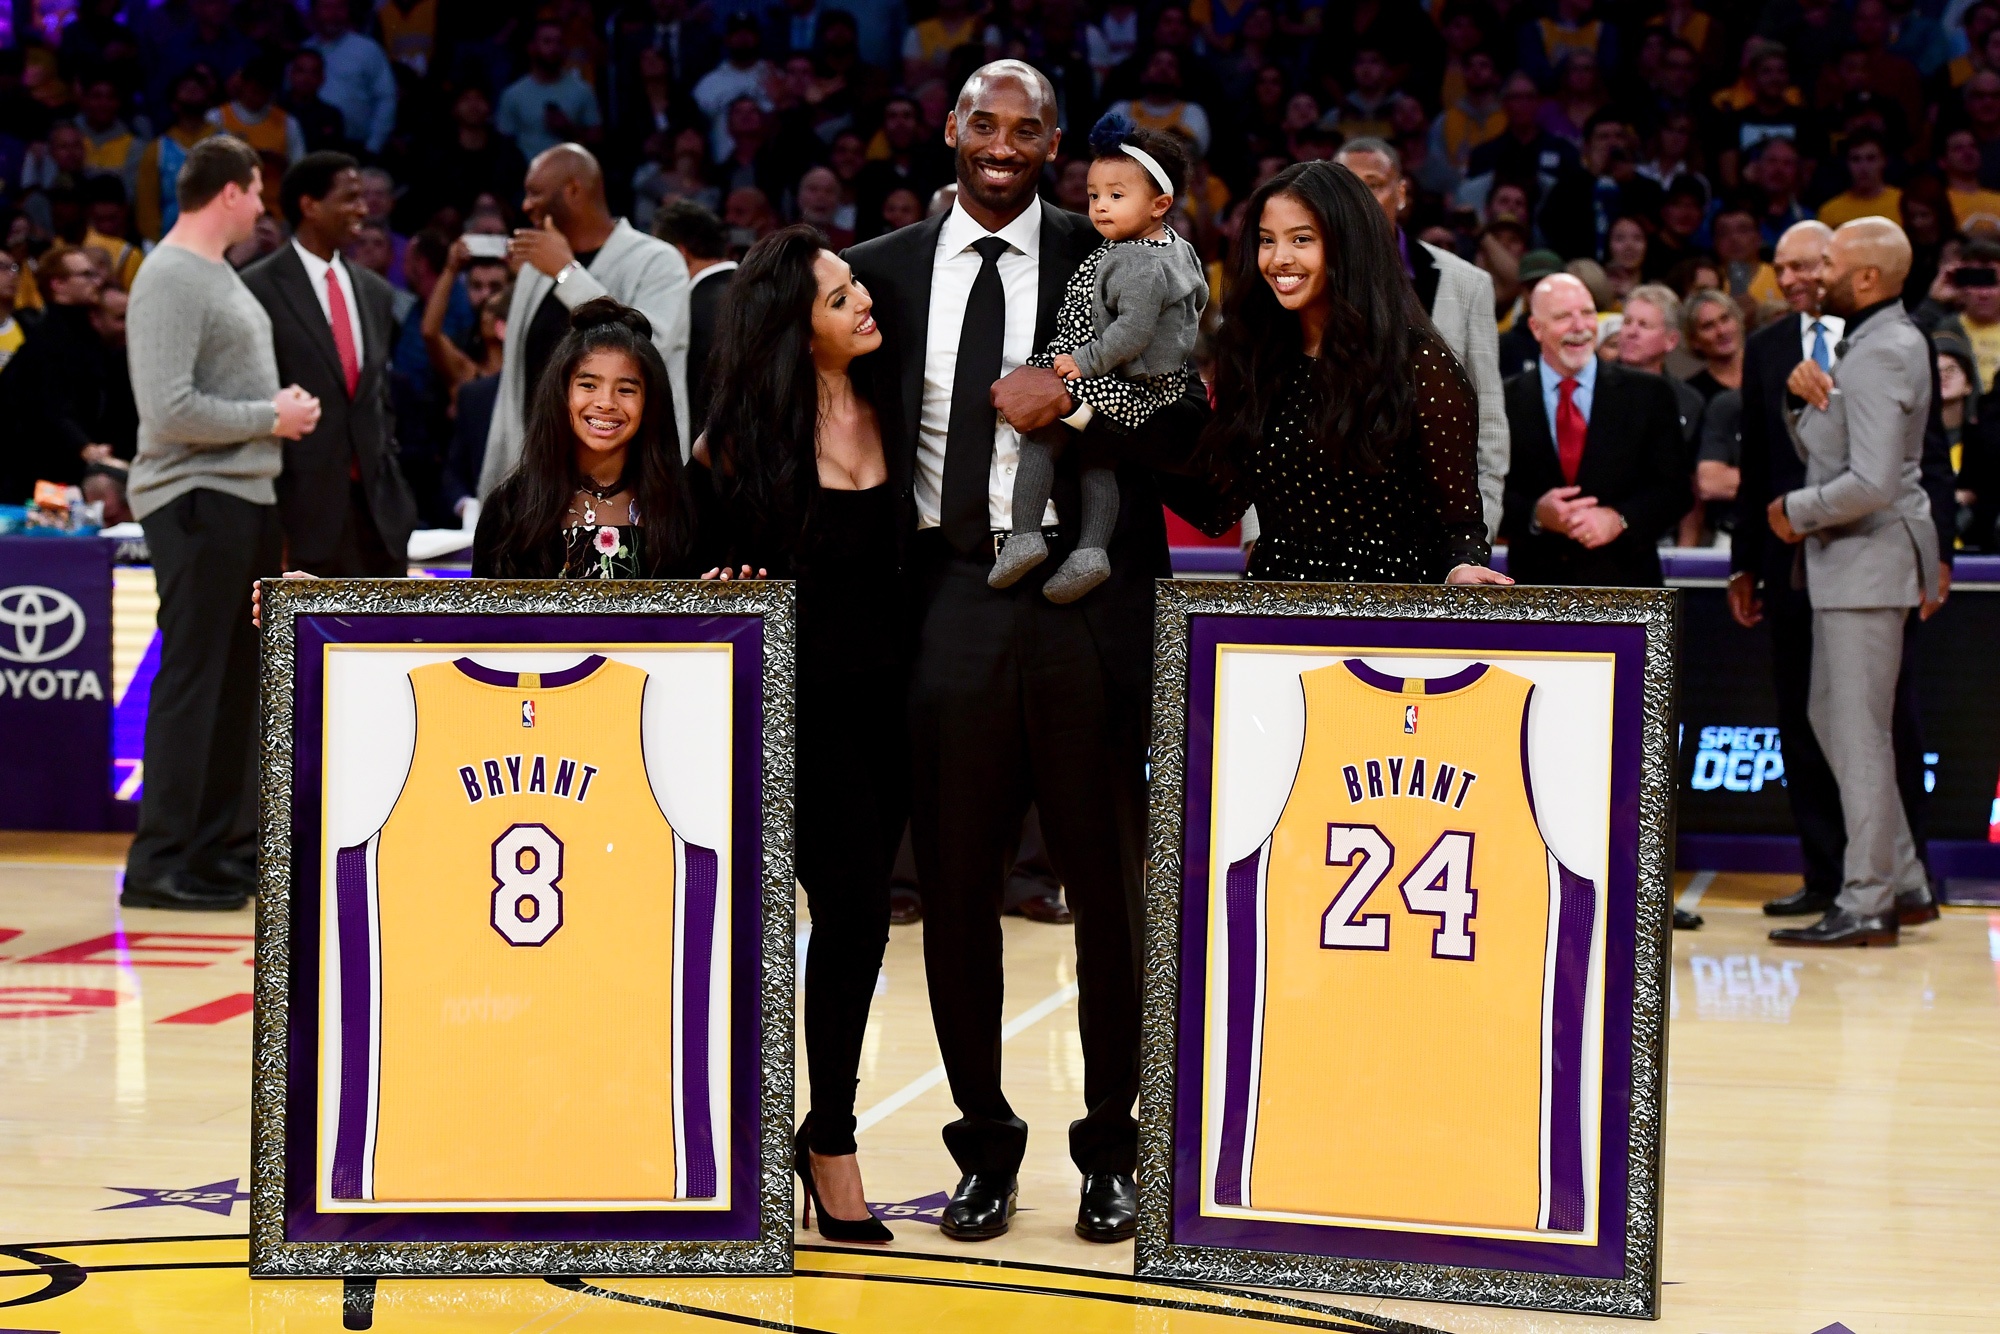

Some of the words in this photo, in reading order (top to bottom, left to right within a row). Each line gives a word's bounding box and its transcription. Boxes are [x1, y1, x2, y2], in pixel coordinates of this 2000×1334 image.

[0, 669, 104, 700] YOTA
[457, 753, 600, 805] BRYANT
[1341, 756, 1478, 811] BRYANT
[490, 823, 564, 947] 8
[1320, 822, 1478, 961] 24
[153, 1191, 233, 1204] '52
[872, 1204, 946, 1218] '54
